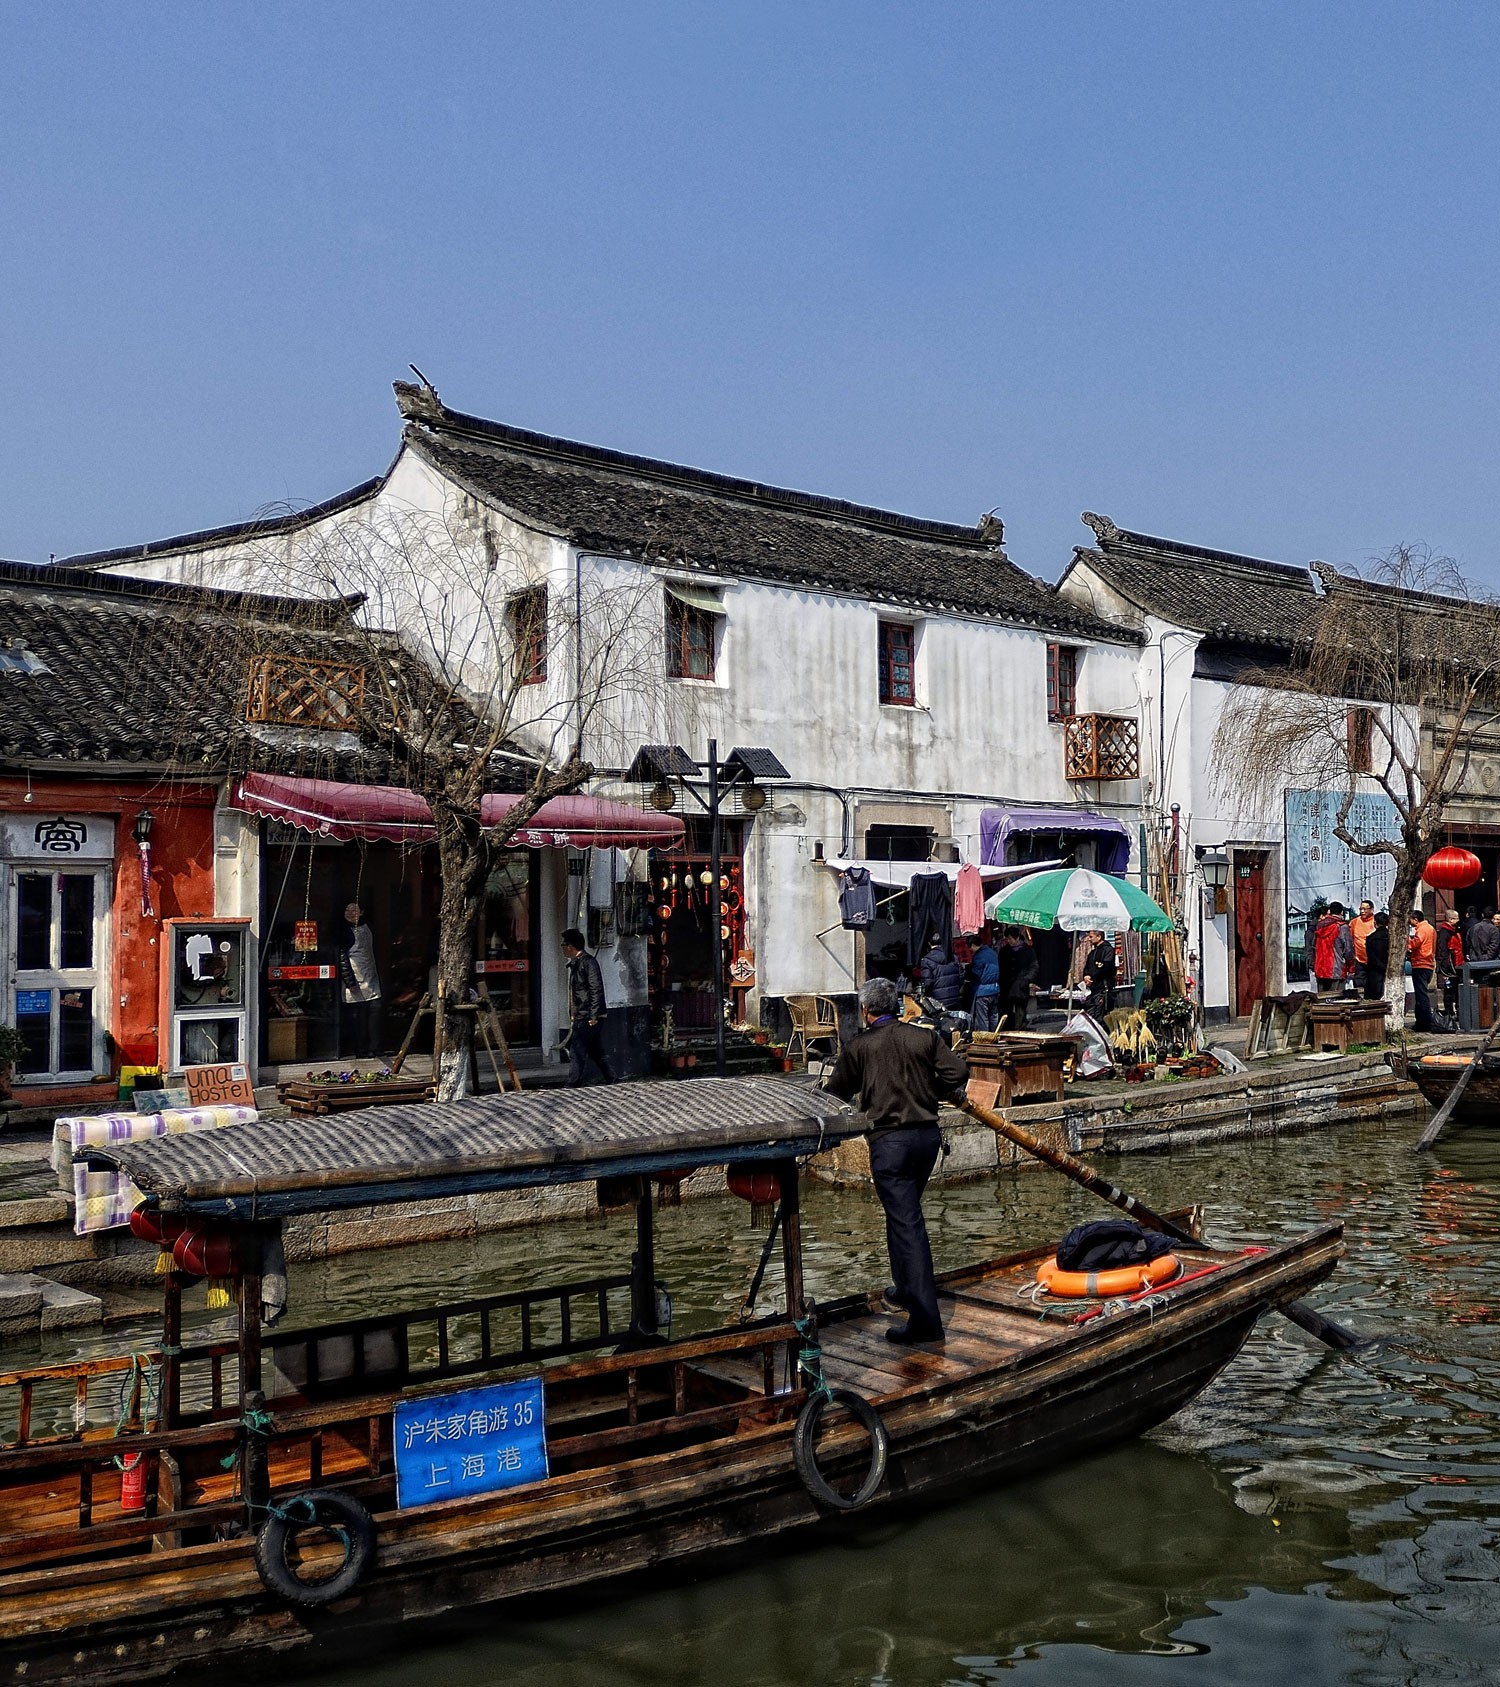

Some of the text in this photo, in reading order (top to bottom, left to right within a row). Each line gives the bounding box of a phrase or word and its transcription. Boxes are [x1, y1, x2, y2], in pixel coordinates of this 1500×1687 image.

[404, 1400, 533, 1449] 沪朱家角游 35
[424, 1445, 522, 1488] 上海港
